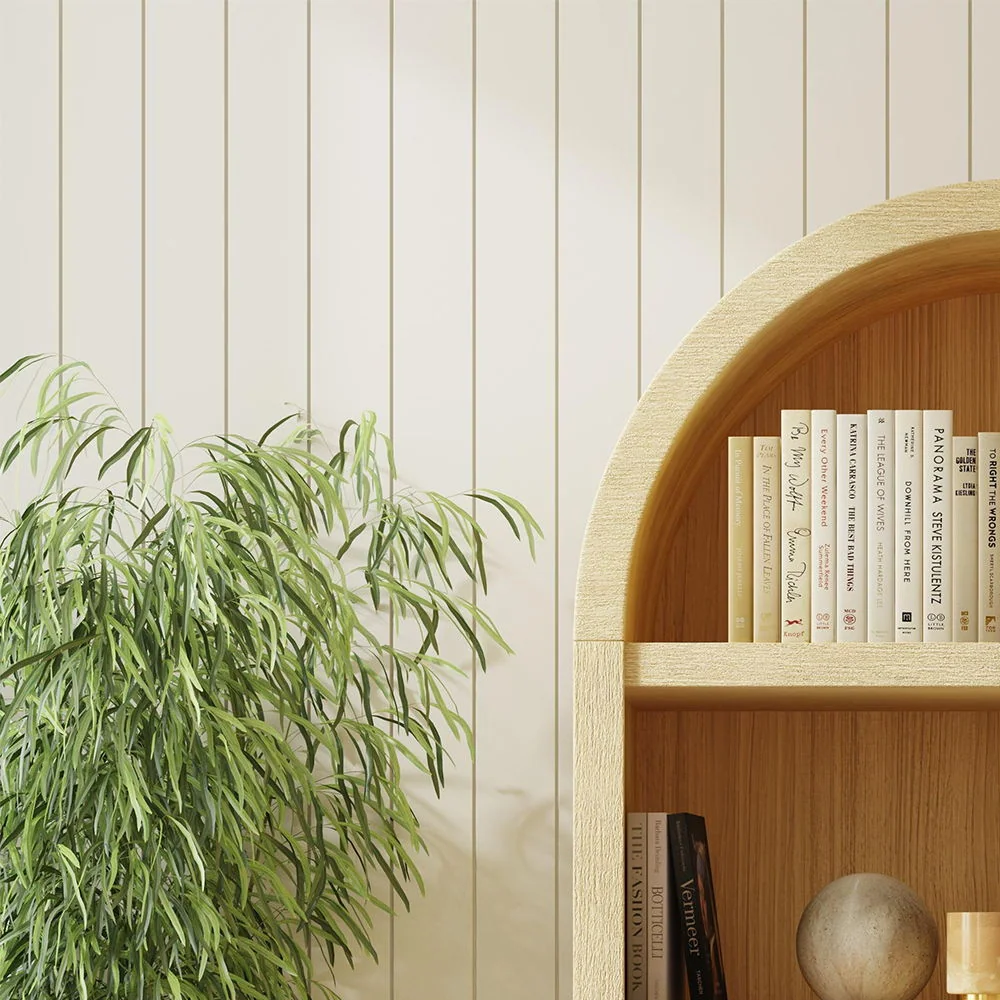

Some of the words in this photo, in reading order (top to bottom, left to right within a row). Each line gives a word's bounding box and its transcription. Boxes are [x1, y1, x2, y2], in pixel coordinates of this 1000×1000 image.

[820, 429, 828, 454] Every
[849, 423, 858, 457] KATRINA
[877, 435, 885, 451] THE
[785, 446, 806, 468] My
[932, 429, 944, 503] PANORAMA
[989, 449, 996, 459] TO
[763, 465, 772, 476] IN
[848, 459, 857, 499] CARRASCO
[876, 453, 885, 486] LEAGUE
[989, 461, 997, 488] RIGHT
[735, 486, 742, 495] of
[763, 477, 771, 493] THE
[876, 489, 885, 501] OF
[734, 496, 742, 527] Memory
[763, 495, 772, 519] PLACE
[848, 507, 856, 522] THE
[876, 505, 885, 531] WIVES
[763, 521, 771, 534] OF
[848, 524, 856, 543] BEST
[932, 512, 942, 541] STEVE
[763, 534, 772, 564] FALLEN
[847, 545, 855, 561] BAD
[846, 563, 855, 592] THINGS
[931, 544, 942, 604] KISTULENTZ
[631, 823, 643, 860] THE
[651, 887, 663, 958] BOTTICELLI
[681, 879, 700, 956] Vermeer
[632, 944, 643, 991] BOOK
